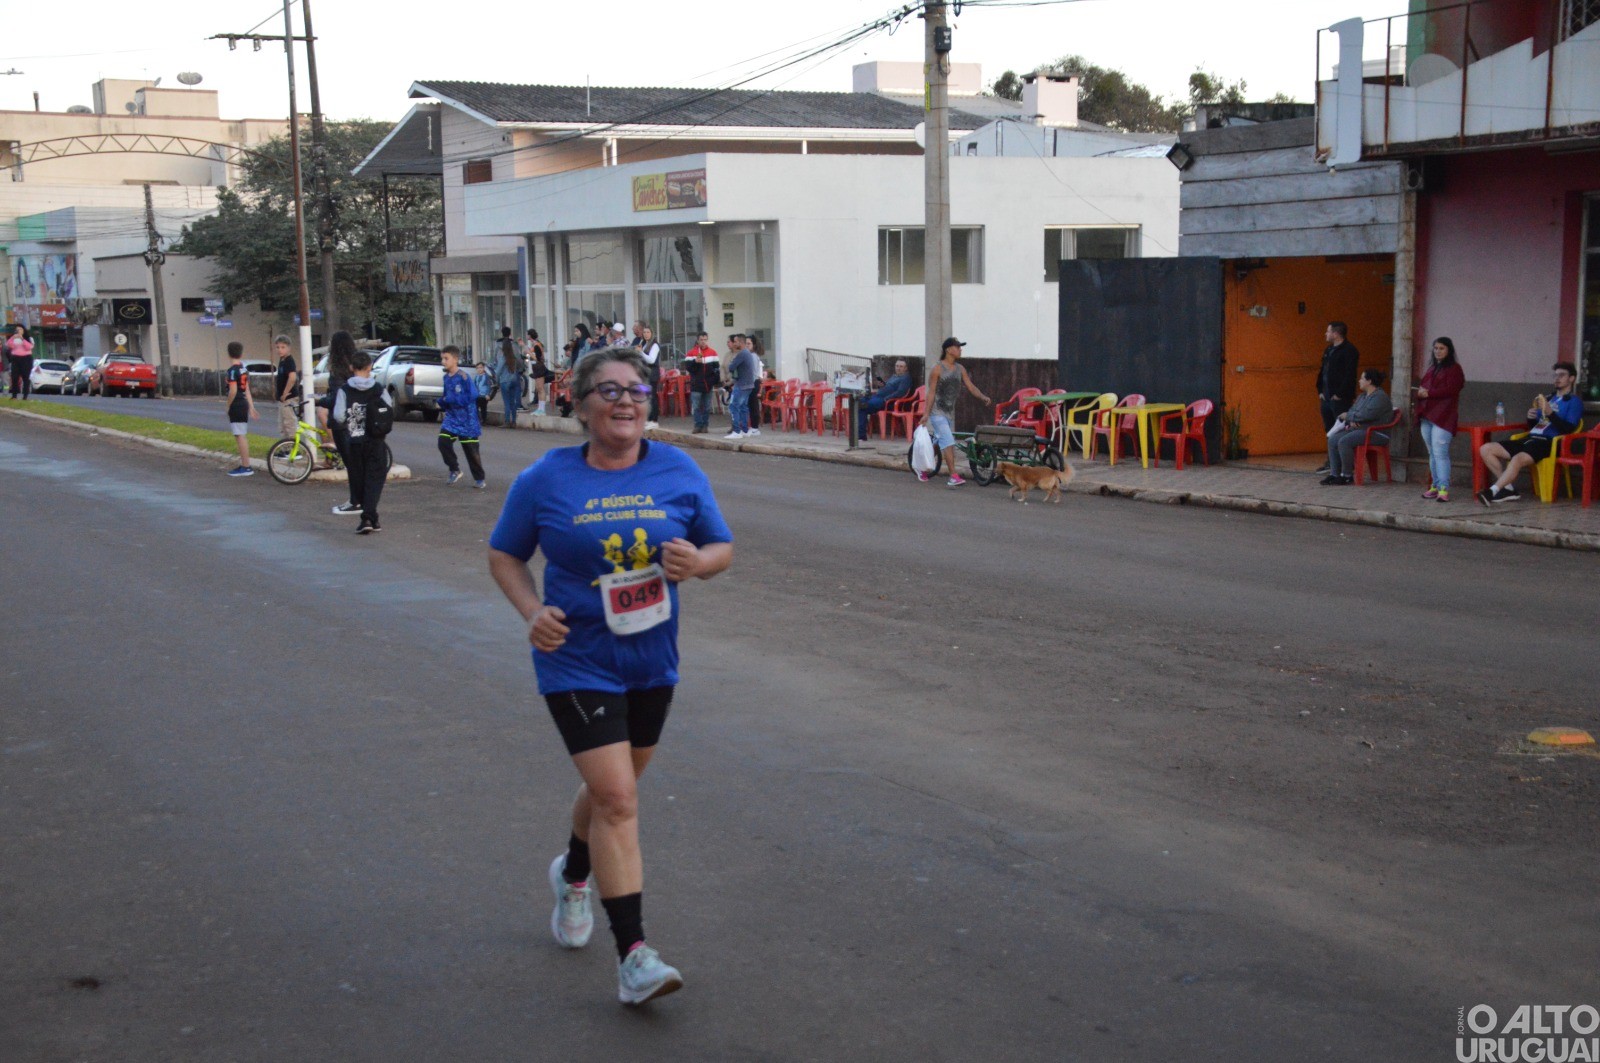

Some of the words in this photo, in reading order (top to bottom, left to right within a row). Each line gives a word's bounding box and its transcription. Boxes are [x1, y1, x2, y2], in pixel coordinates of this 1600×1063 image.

[602, 494, 654, 507] RÚSTICA
[573, 512, 603, 524] LIONS
[605, 510, 636, 520] CLUBE
[618, 582, 659, 609] 049
